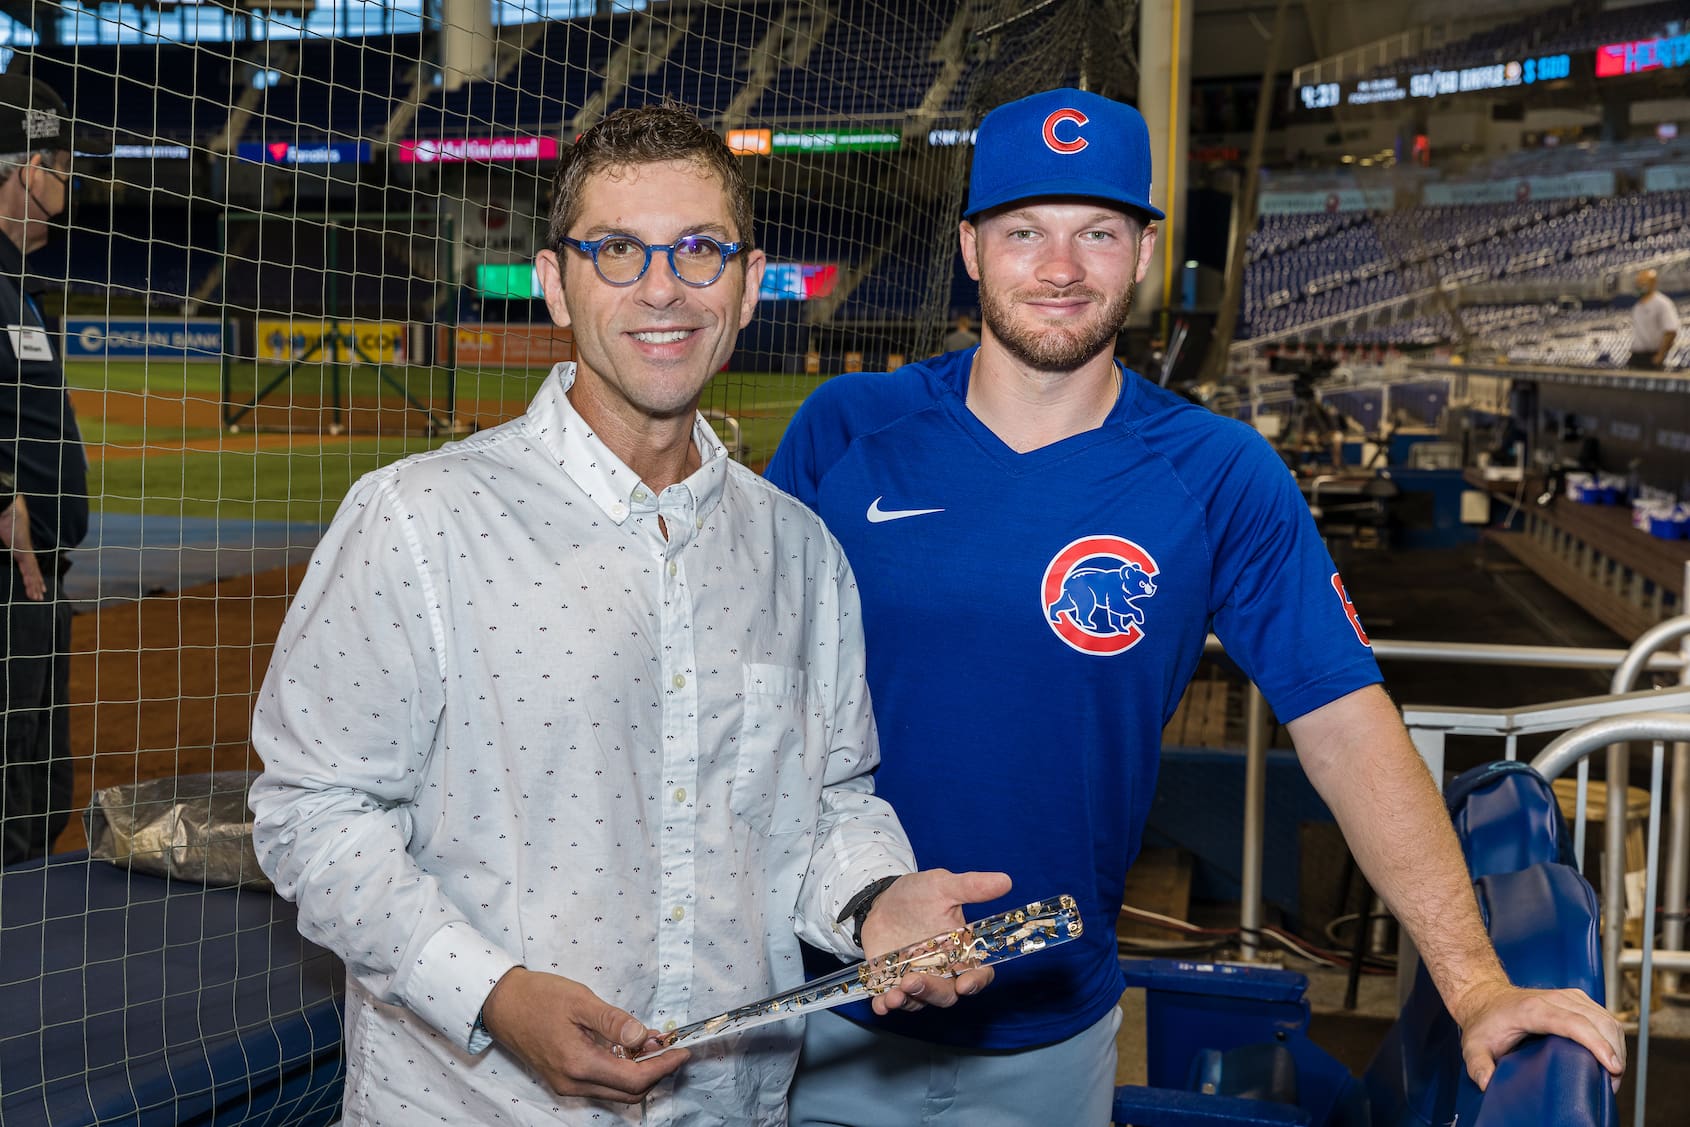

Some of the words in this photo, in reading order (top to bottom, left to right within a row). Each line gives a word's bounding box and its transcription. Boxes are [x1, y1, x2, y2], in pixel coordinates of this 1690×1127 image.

[1042, 108, 1089, 154] C
[108, 331, 169, 348] OCEAN
[171, 332, 221, 349] BANK
